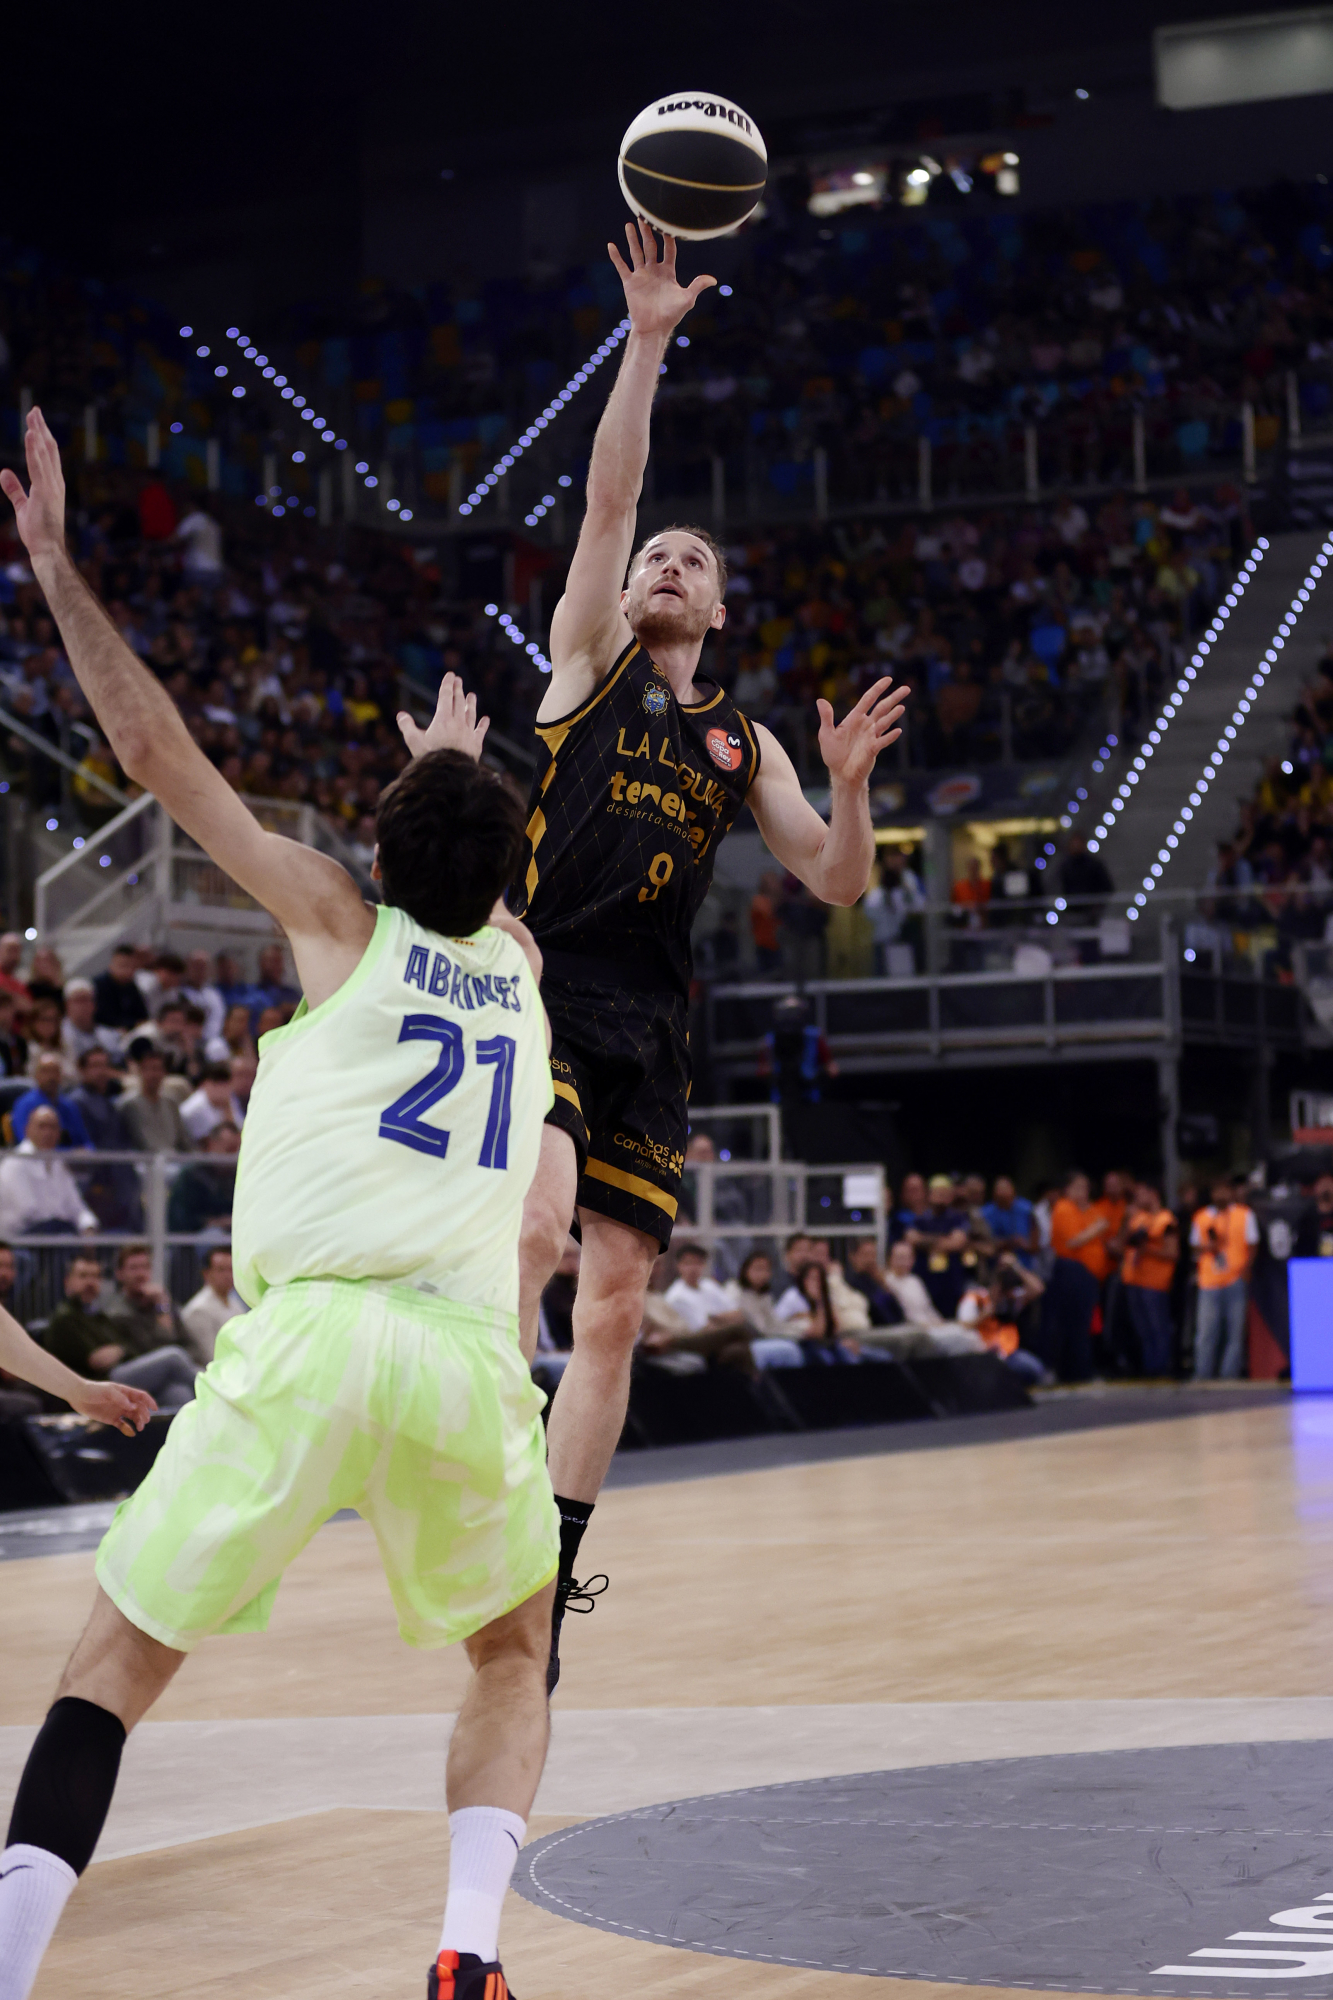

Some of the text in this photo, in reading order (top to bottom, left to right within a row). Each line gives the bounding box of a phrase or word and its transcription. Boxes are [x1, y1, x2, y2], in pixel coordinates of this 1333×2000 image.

[658, 101, 752, 137] Wilson
[711, 739, 730, 755] Copa
[718, 750, 732, 763] Rey
[616, 727, 725, 818] LA LGUNA
[606, 801, 662, 826] despierta
[637, 852, 674, 903] 9
[403, 944, 522, 1013] ABRINES
[378, 1014, 516, 1171] 21
[613, 1132, 668, 1168] Canarias
